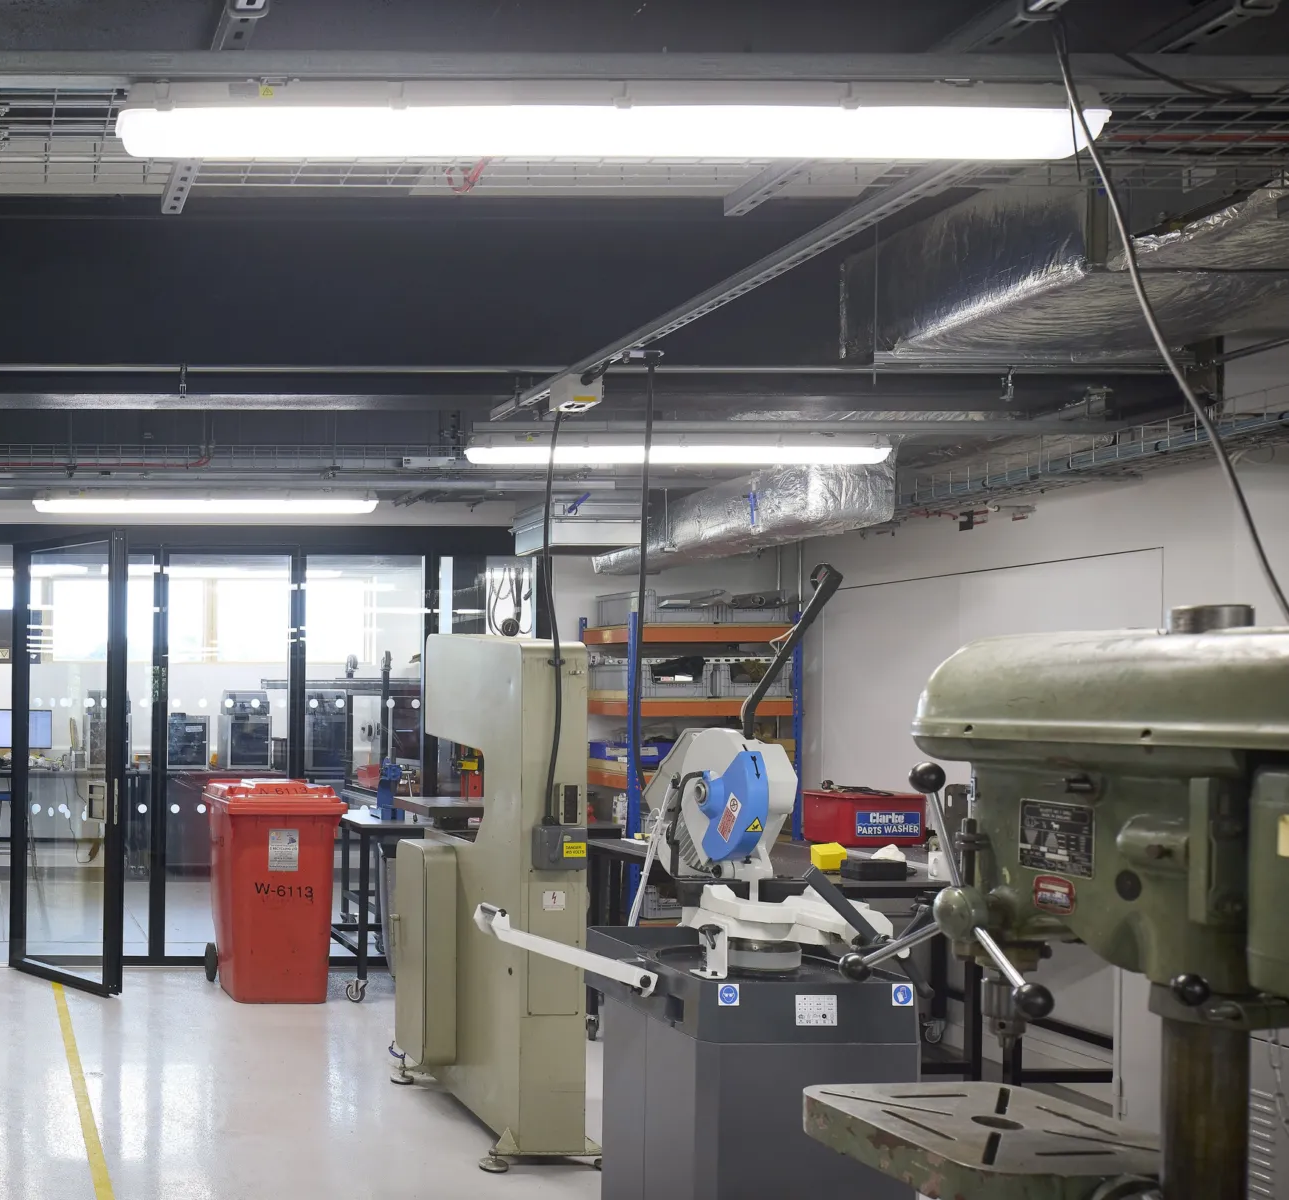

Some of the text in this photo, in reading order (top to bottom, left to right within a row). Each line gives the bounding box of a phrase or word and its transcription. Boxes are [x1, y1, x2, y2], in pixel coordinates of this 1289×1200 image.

[870, 812, 905, 824] Clarke
[857, 825, 919, 834] PARTS WASHER
[254, 882, 314, 899] W-6113
